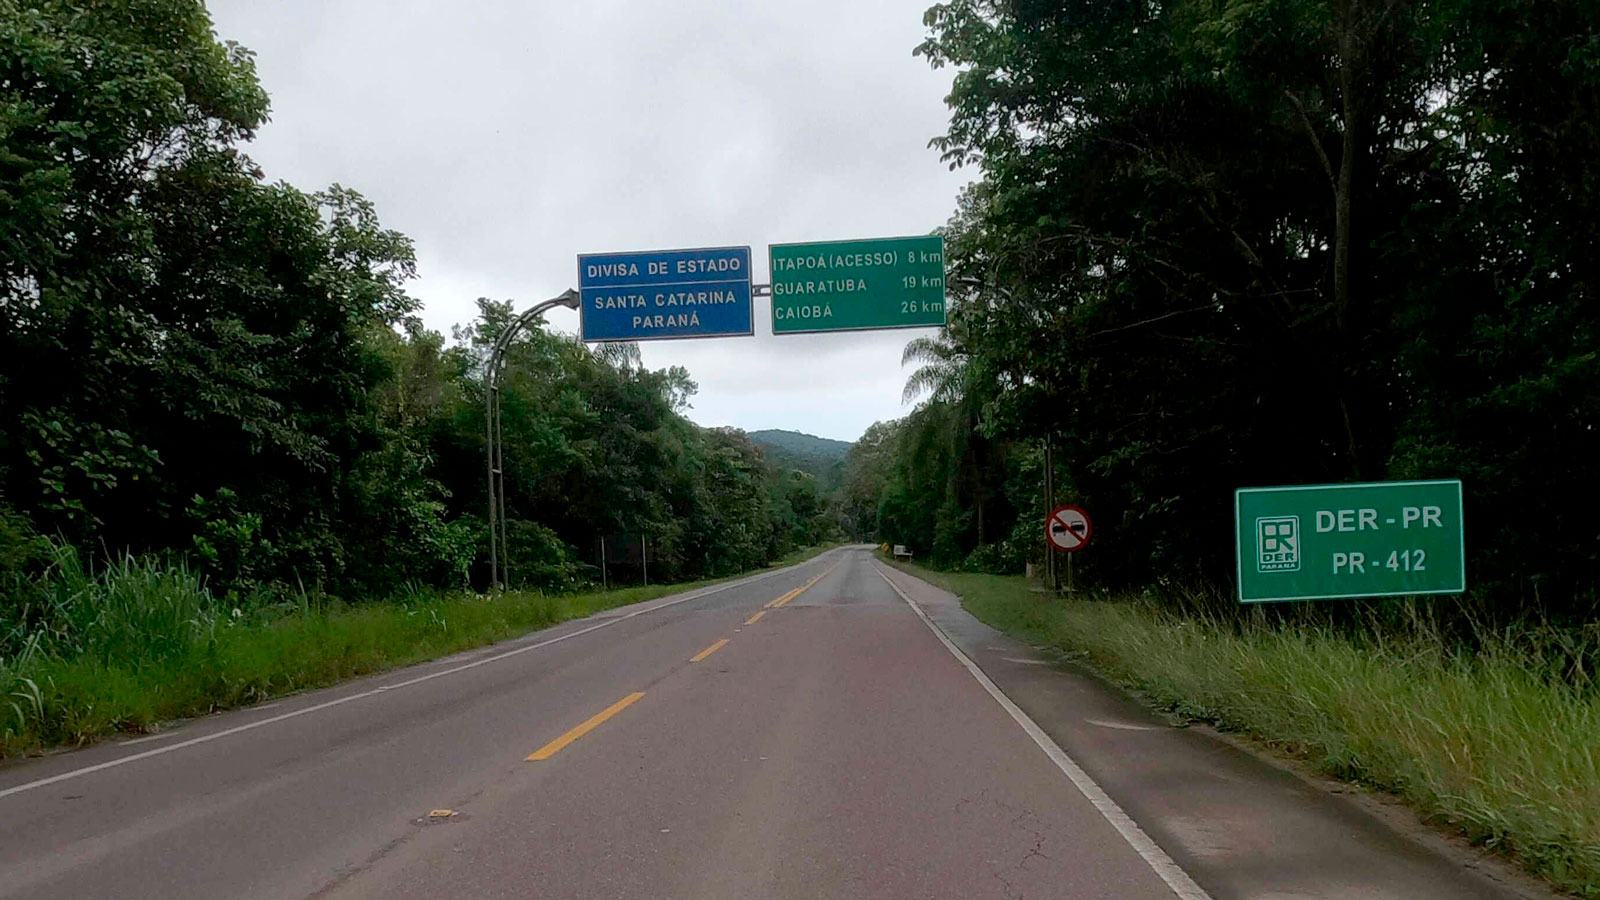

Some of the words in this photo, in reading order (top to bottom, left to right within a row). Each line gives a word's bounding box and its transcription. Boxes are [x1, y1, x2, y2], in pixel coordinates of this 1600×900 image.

[587, 263, 639, 278] DIVISA
[648, 262, 669, 274] DE
[677, 257, 741, 273] ESTADO
[773, 253, 826, 271] ITAPOÁ
[829, 250, 898, 269] (ACESSO)
[908, 252, 915, 263] 8
[920, 251, 941, 263] km
[774, 279, 867, 295] GUARATUBA
[902, 276, 916, 289] 19
[922, 276, 942, 287] km
[595, 295, 647, 309] SANTA
[655, 291, 736, 306] CATARINA
[632, 311, 700, 329] PARANÁ
[775, 302, 833, 320] CAIOBÁ
[901, 301, 917, 313] 26
[922, 301, 942, 313] km
[1316, 509, 1379, 533] DER
[1402, 506, 1443, 529] PR
[1262, 553, 1295, 563] DER
[1333, 552, 1365, 574] PR
[1386, 550, 1426, 572] 412
